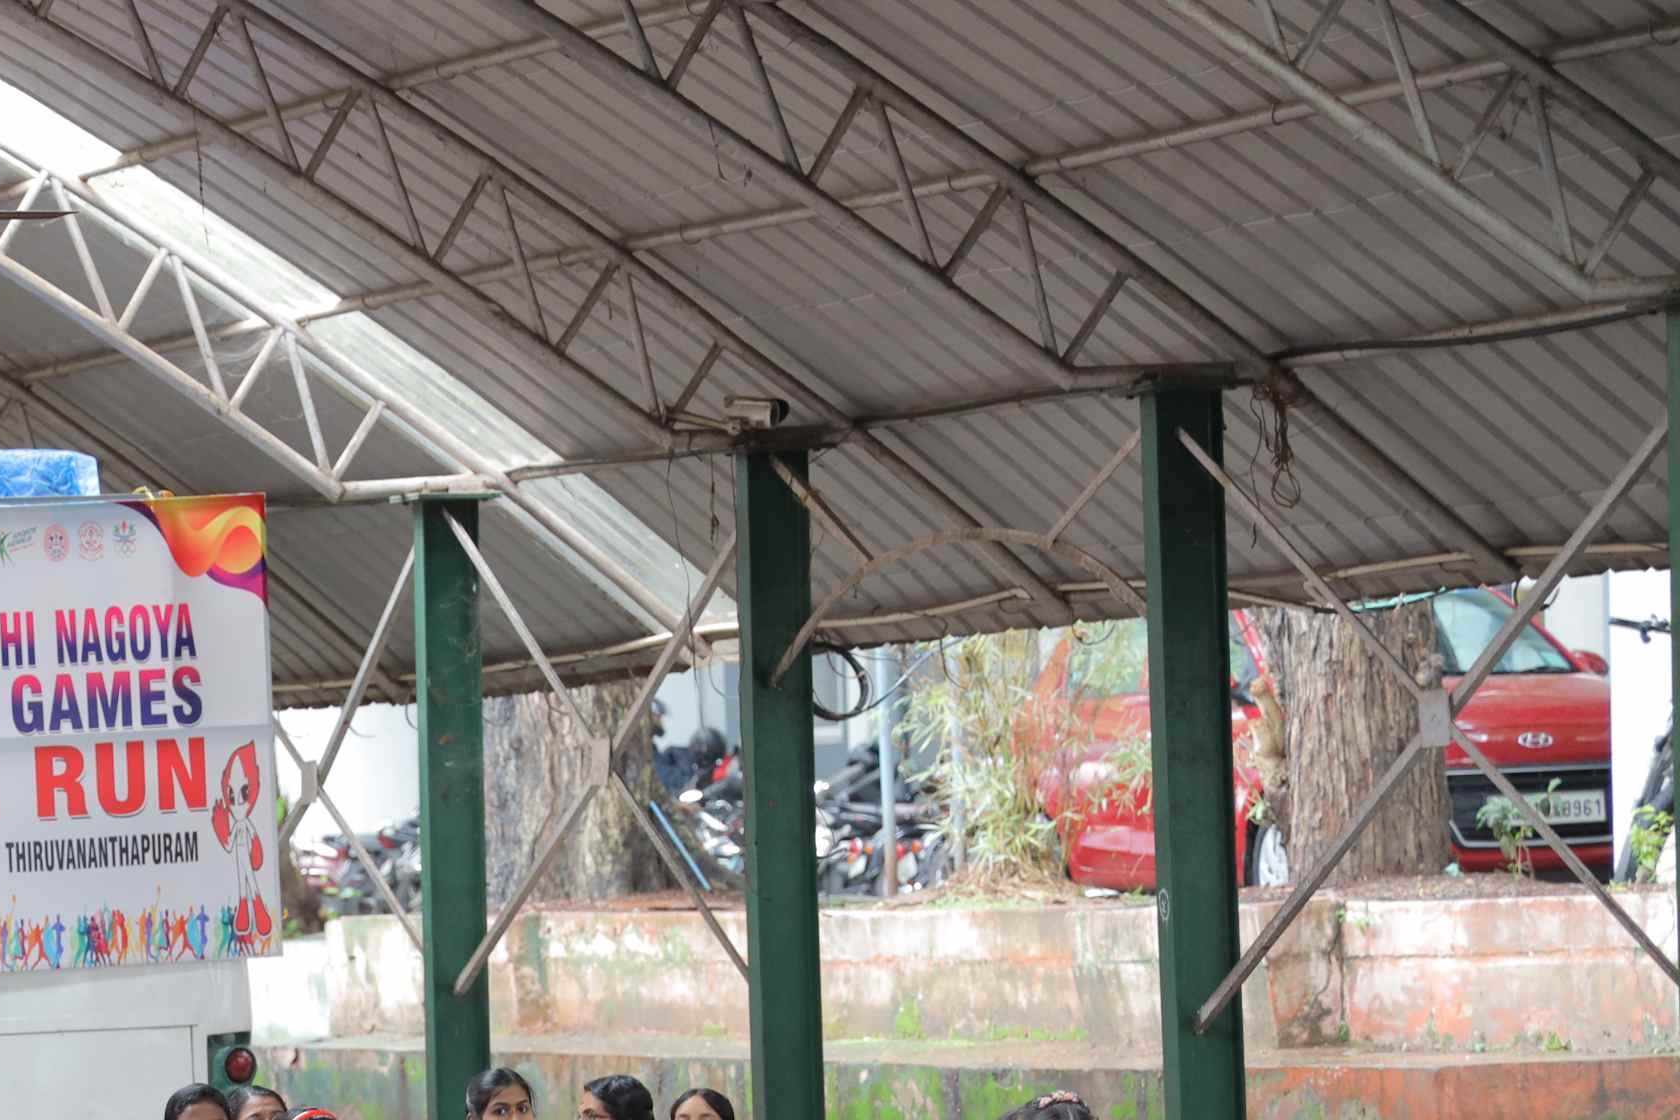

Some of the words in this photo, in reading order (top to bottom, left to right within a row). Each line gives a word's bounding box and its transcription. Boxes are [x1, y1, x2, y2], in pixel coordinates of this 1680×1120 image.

[55, 602, 198, 665] NAGOYA
[11, 666, 203, 735] GAMES
[34, 736, 209, 821] RUN
[6, 831, 199, 873] THIRUVANANTHAPURAM
